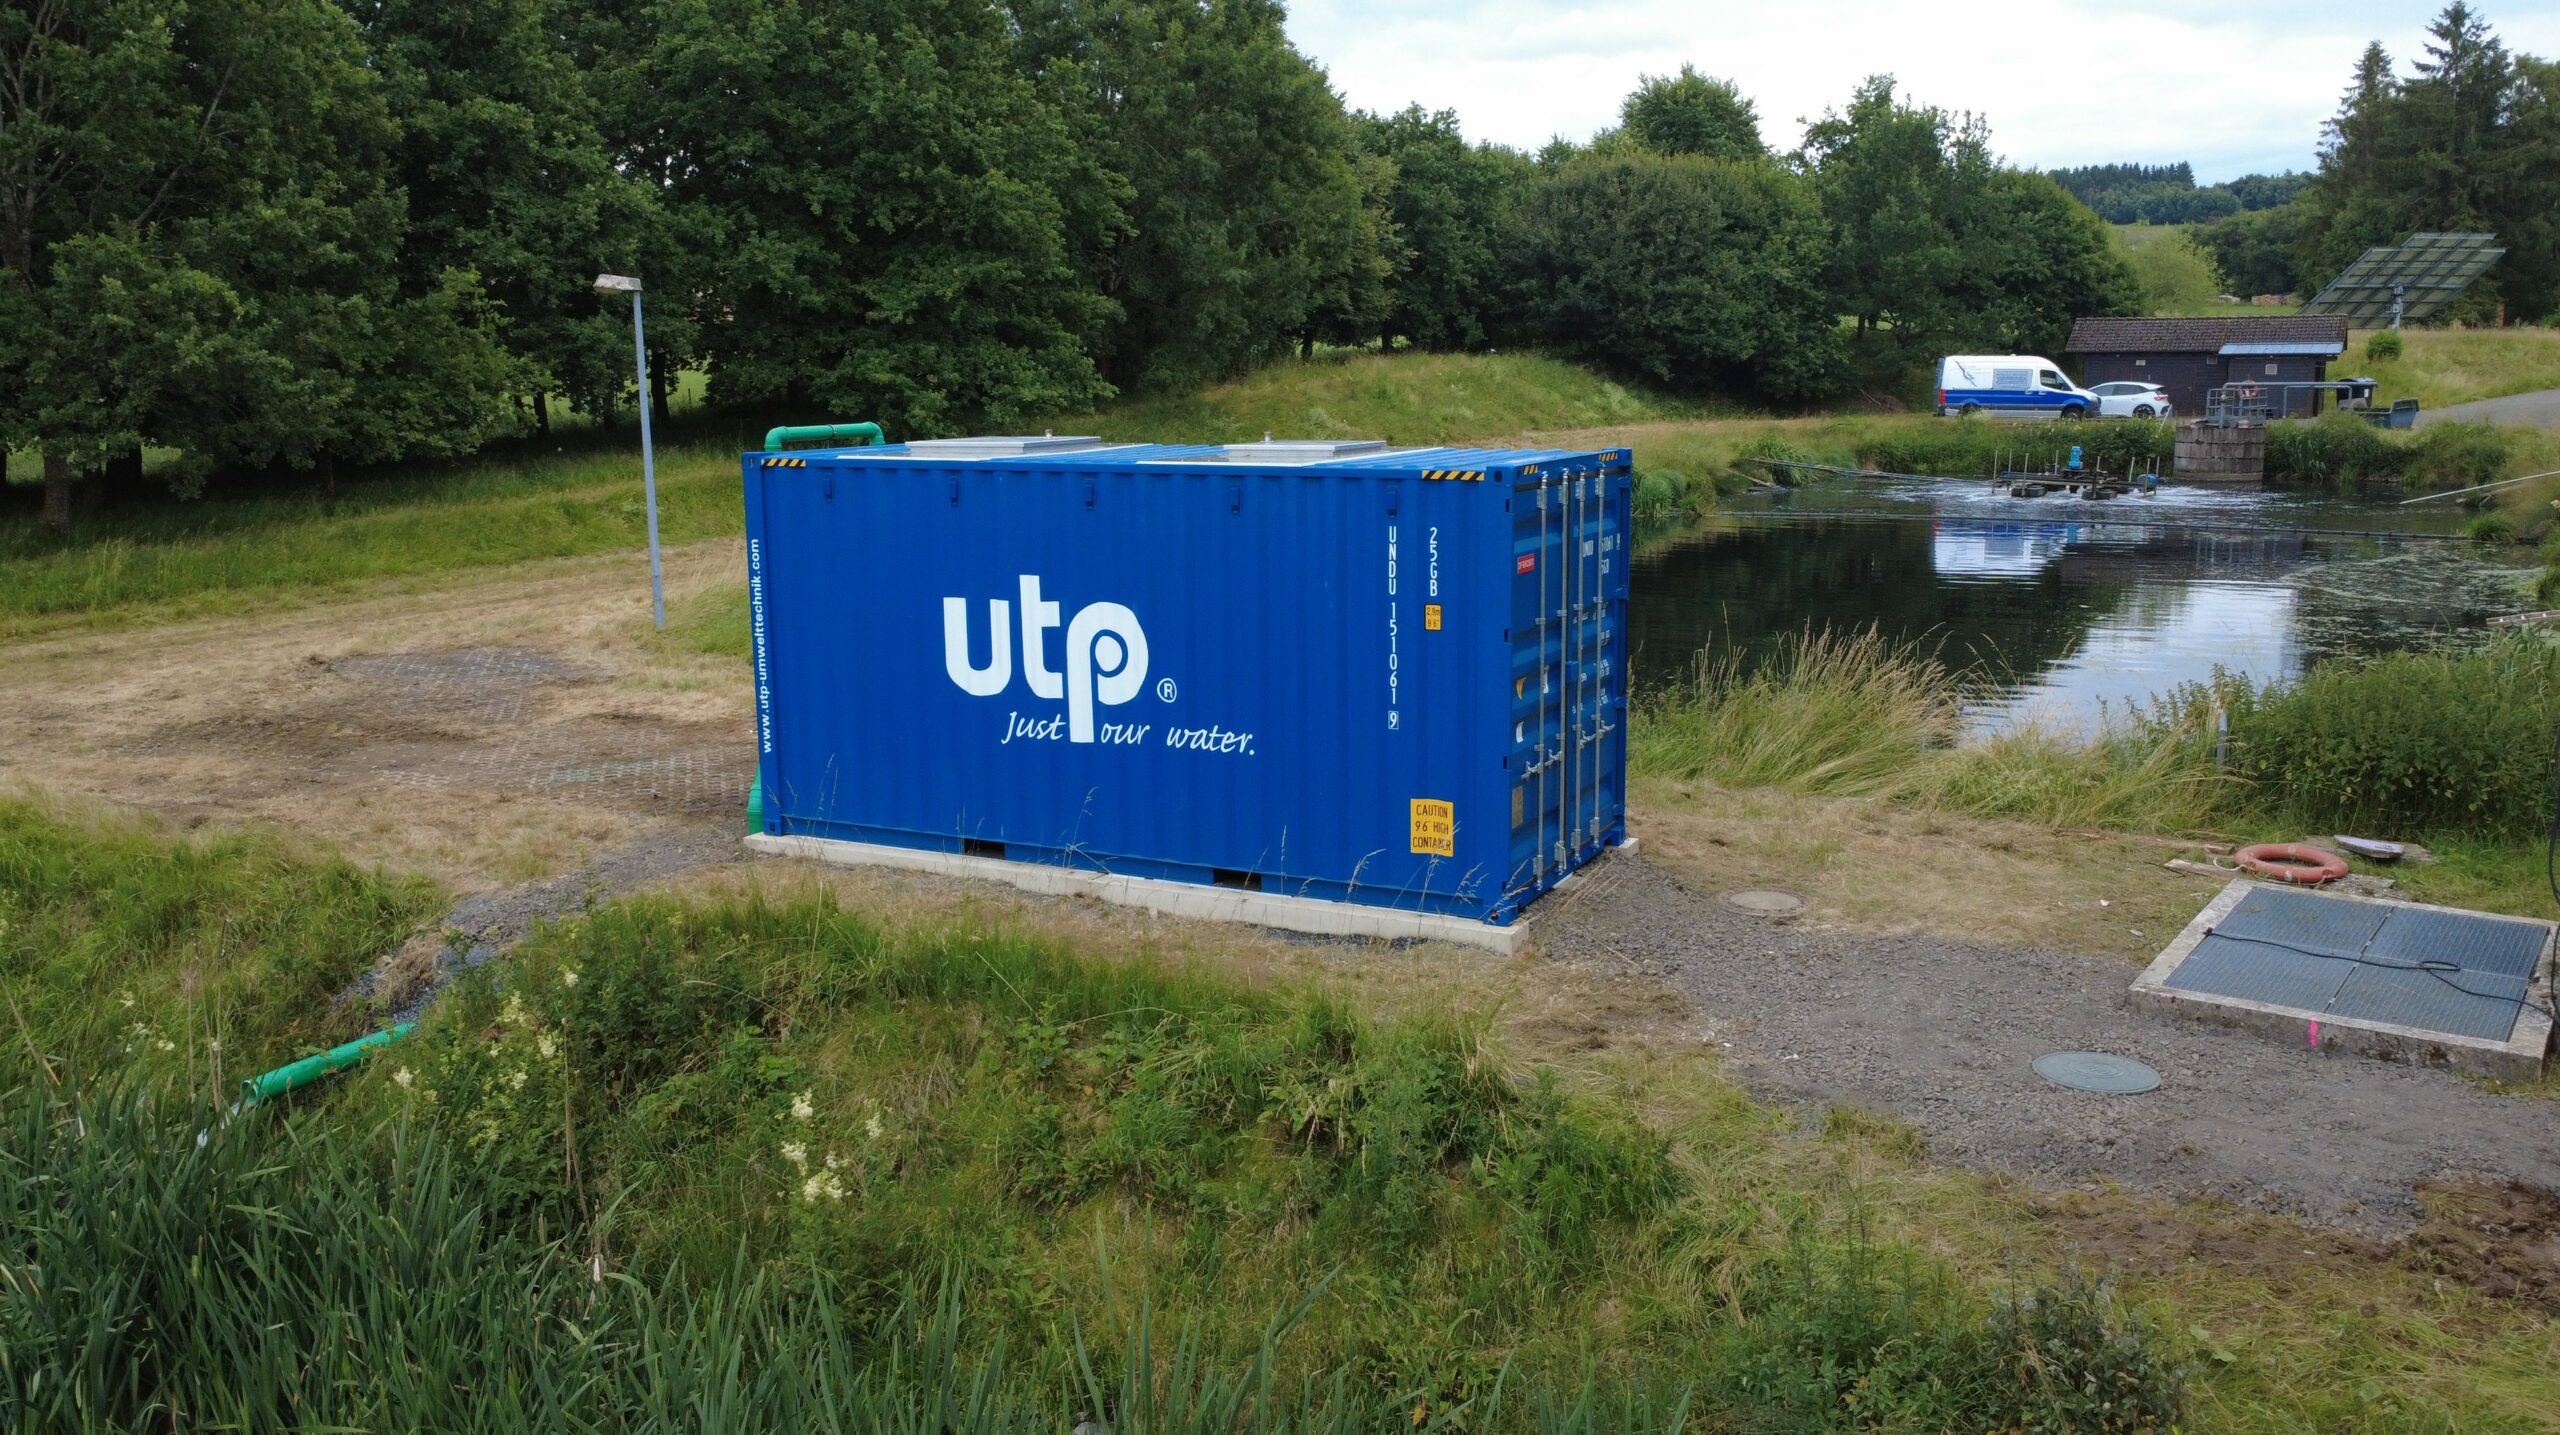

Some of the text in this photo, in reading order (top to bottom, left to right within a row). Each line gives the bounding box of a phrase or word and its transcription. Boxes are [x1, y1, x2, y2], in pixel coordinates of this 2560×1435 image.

[1429, 526, 1438, 597] 25GB
[751, 538, 772, 754] www.utp-umwelttechnik.com
[943, 574, 1149, 743] utp
[1388, 525, 1398, 729] UNDU 151061 9
[1166, 724, 1256, 756] water.
[1416, 804, 1448, 819] CAUTION
